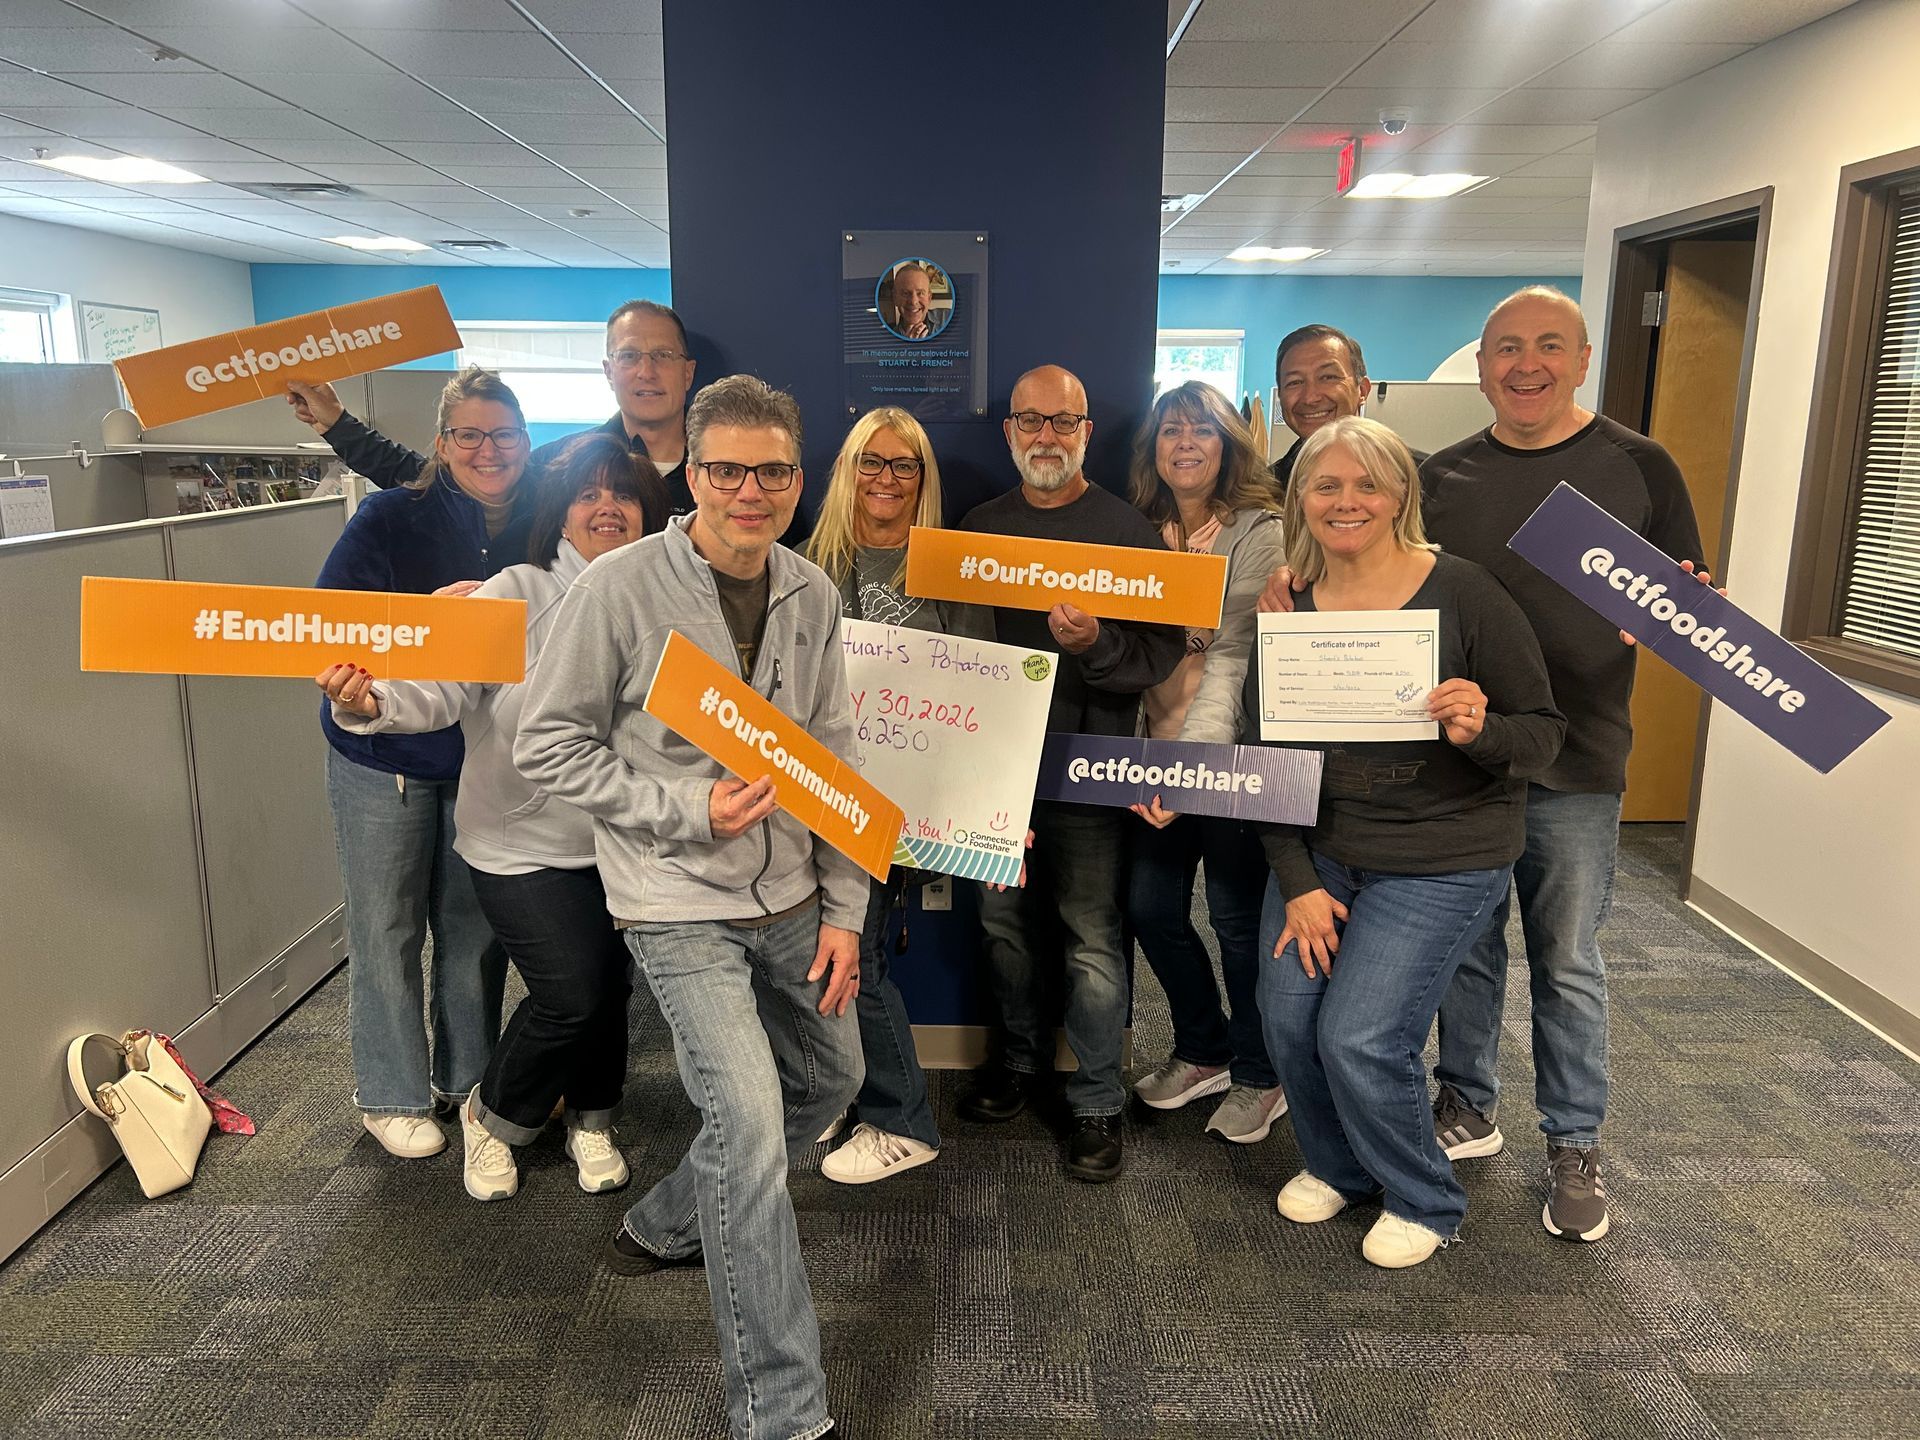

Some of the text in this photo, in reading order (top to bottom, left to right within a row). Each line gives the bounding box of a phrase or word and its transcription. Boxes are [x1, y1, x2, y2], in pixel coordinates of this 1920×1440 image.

[185, 318, 402, 393] @ctfoodshare
[871, 350, 898, 358] memory
[900, 349, 907, 357] of
[921, 349, 948, 358] beloved
[949, 349, 969, 358] friend
[878, 359, 953, 367] STUART C. FRENCH
[960, 555, 1164, 599] #OurFoodBank
[193, 610, 430, 653] #EndHunger
[1311, 641, 1380, 649] Certificate of Impact
[1580, 546, 1806, 714] @ctfoodshare
[842, 626, 1010, 681] tuart's Potatoes
[1022, 657, 1044, 669] Thank
[699, 686, 871, 836] #OurCommunity
[1068, 757, 1263, 794] @ctfoodshare
[918, 817, 952, 842] You!
[970, 831, 1018, 847] Connecticut
[969, 839, 1010, 853] Foodshare
